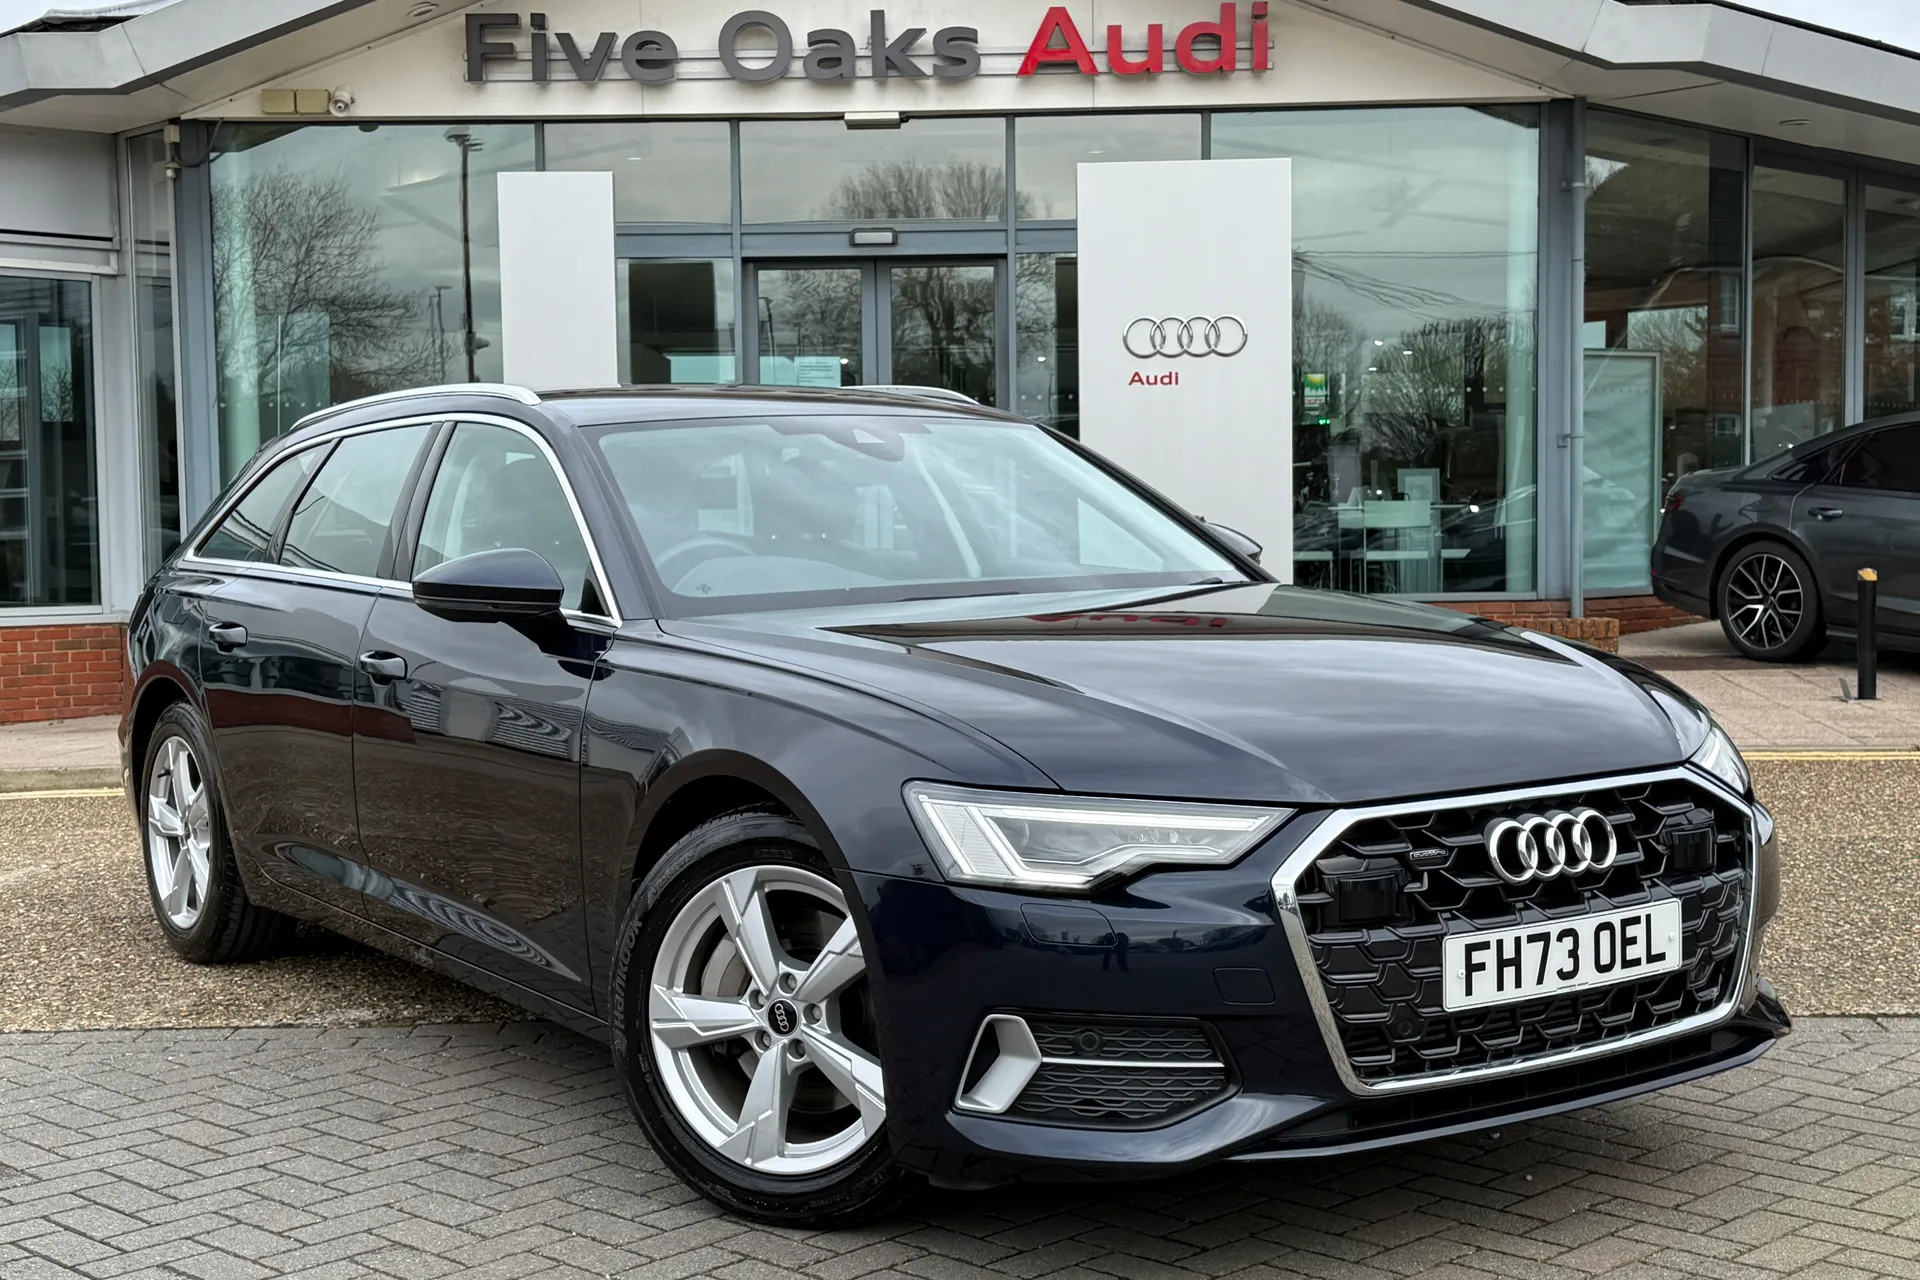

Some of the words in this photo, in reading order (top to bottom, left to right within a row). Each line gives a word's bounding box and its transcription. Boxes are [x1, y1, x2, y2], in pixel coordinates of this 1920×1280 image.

[465, 12, 679, 84] Five
[718, 9, 981, 84] Oaks
[1017, 2, 1268, 77] Audi
[1128, 371, 1179, 386] Audi
[1465, 927, 1580, 997] FH73
[1594, 913, 1666, 974] OEL
